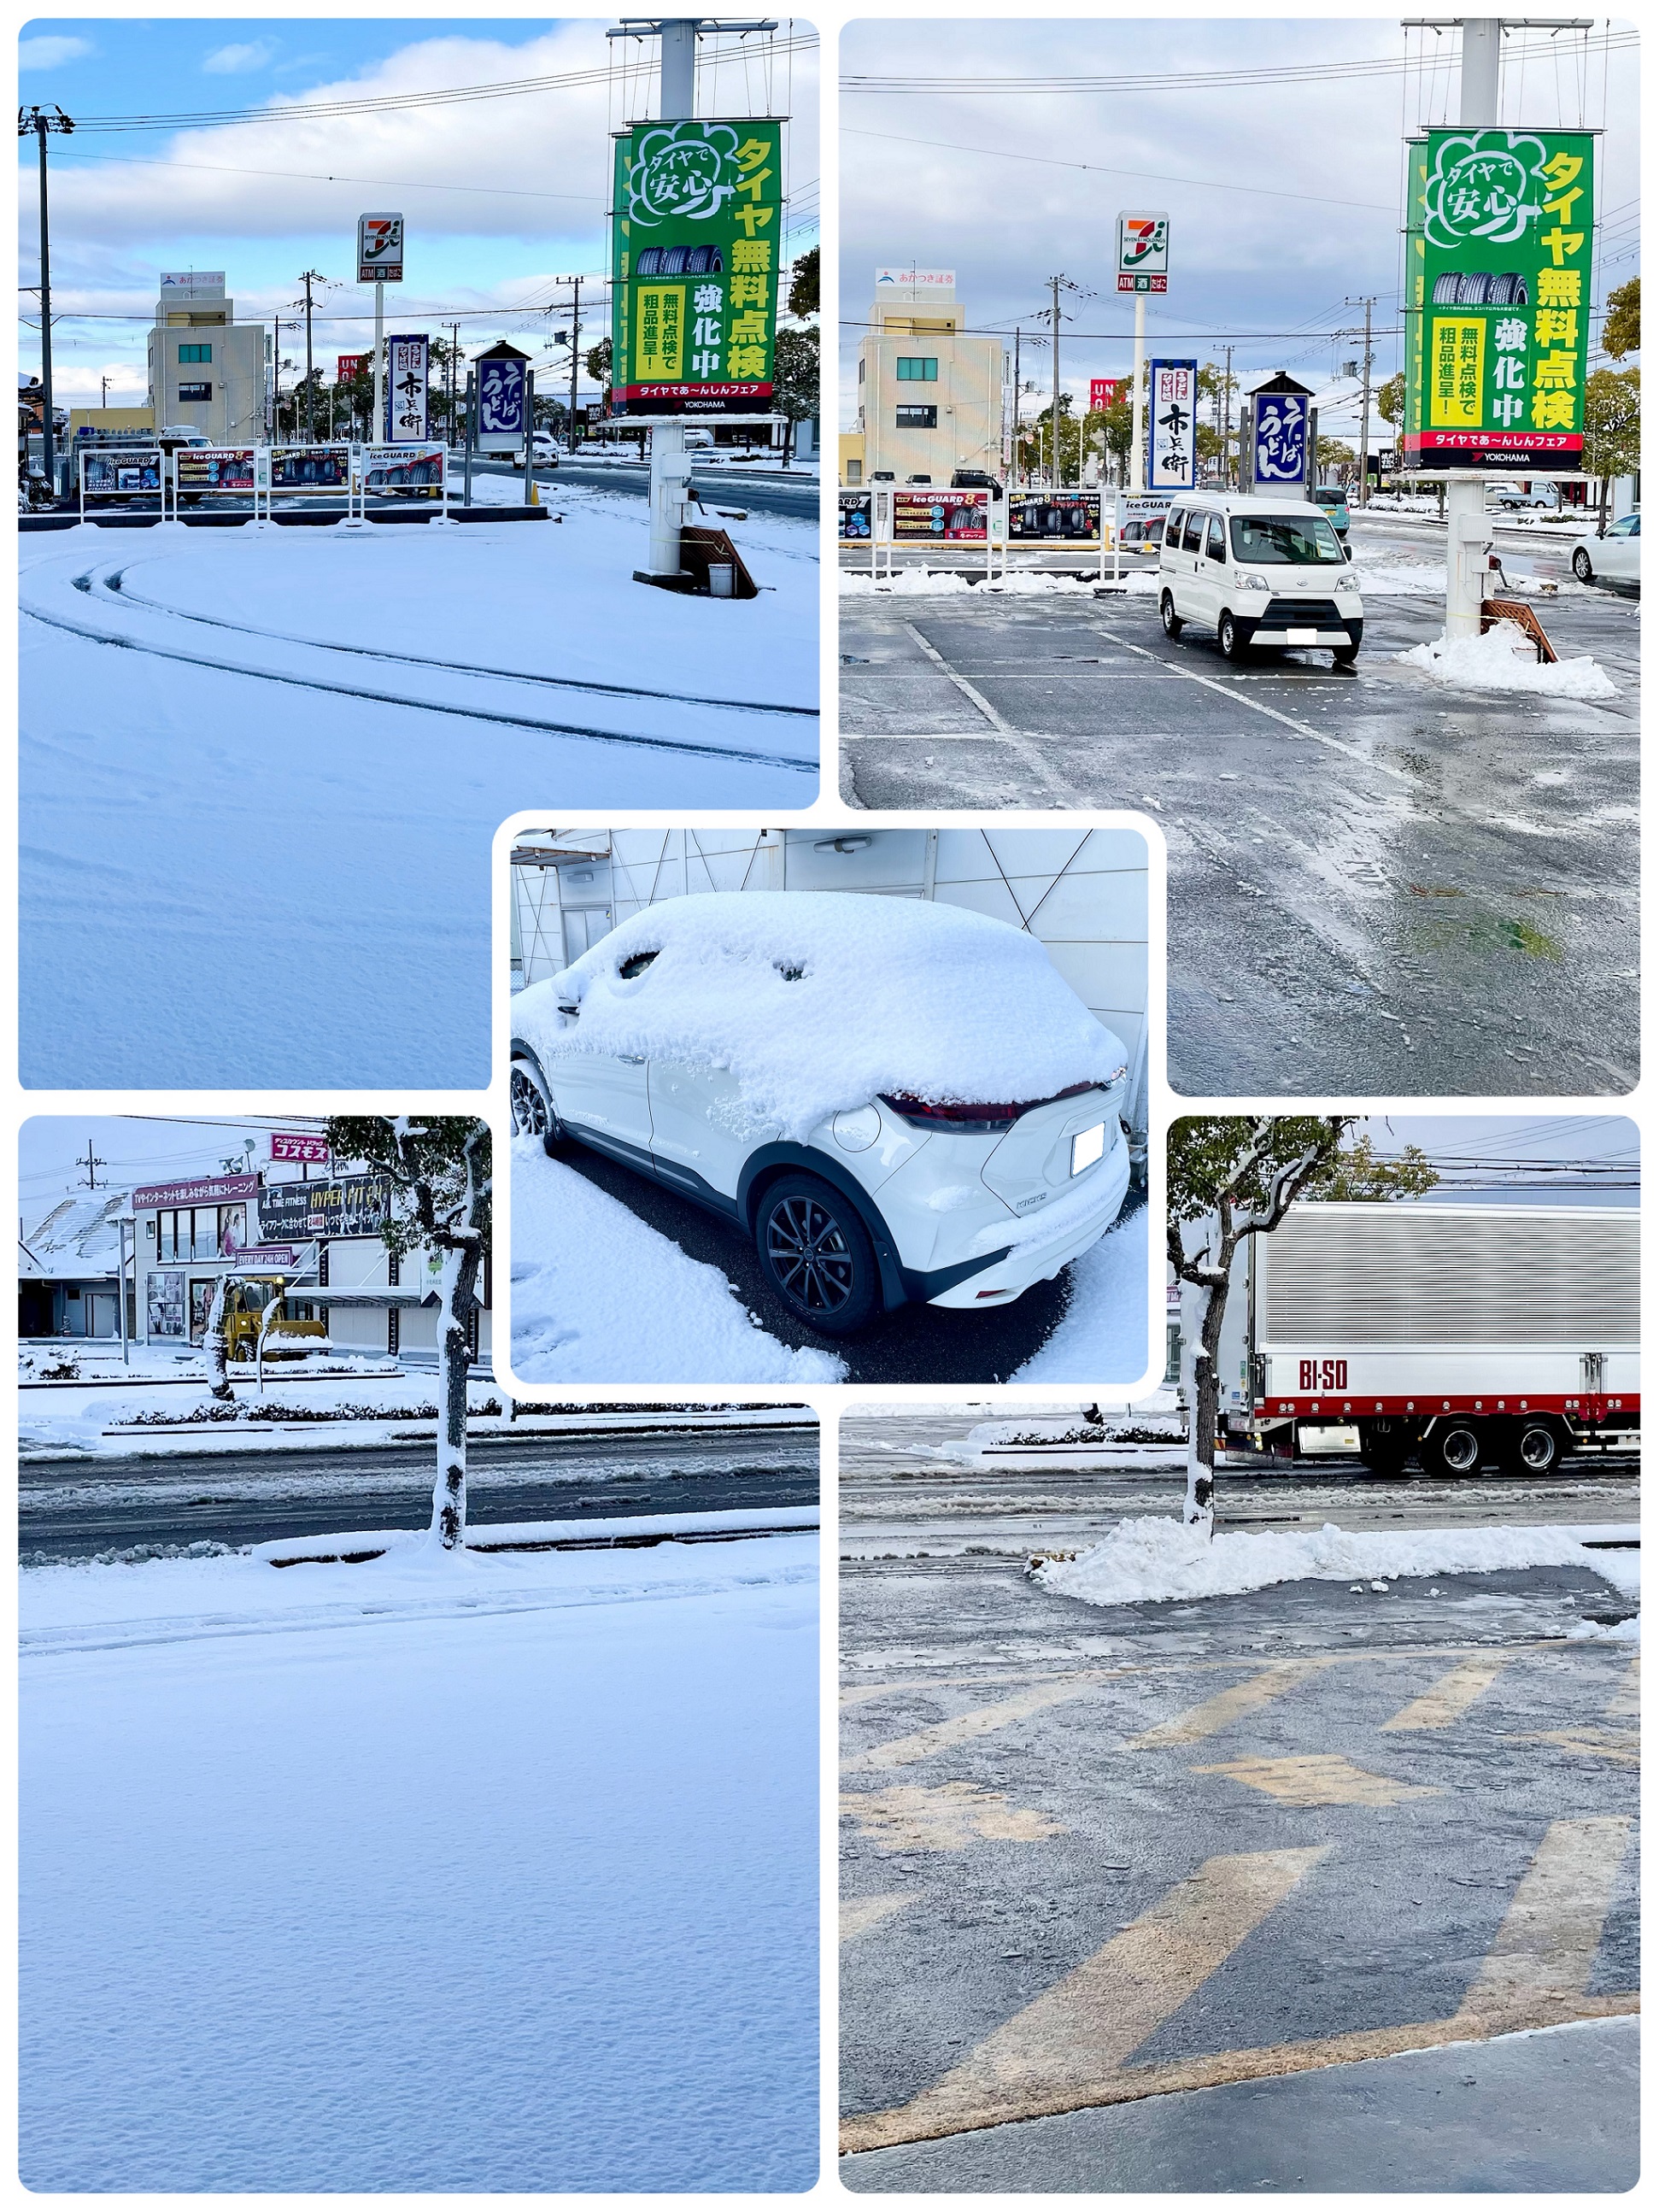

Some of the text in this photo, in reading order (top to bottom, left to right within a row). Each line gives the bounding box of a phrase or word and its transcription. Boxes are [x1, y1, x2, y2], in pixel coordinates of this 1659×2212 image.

[649, 147, 709, 174] タイヤで
[1446, 160, 1514, 187] タイヤで
[649, 169, 712, 205] 安心
[1447, 185, 1517, 224] 安心
[726, 138, 774, 380] タイヤ無料点検
[361, 268, 374, 278] ATM
[376, 268, 386, 279] 酒
[900, 273, 954, 284] あかつき証券
[1118, 277, 1134, 288] ATM
[1137, 278, 1148, 289] 酒
[1152, 279, 1166, 289] たばこ
[1531, 152, 1585, 430] タイヤ無料点検
[662, 293, 679, 370] 無料点検で
[691, 284, 724, 378] 強化中
[1459, 327, 1479, 416] 無料点検で
[1492, 317, 1528, 428] 強化中
[504, 361, 521, 418] そば
[396, 372, 424, 437] 市兵衛
[483, 369, 519, 430] うどん
[1282, 396, 1304, 464] そば
[1158, 403, 1191, 481] 市兵衛
[1258, 406, 1302, 478] うどん
[109, 455, 159, 465] iceGUARD 7
[235, 450, 243, 461] 8
[272, 449, 306, 462] iceGUARD 8
[417, 450, 426, 459] 8
[1485, 453, 1530, 462] YOKOHAMA
[858, 496, 871, 508] 7
[912, 494, 975, 504] iceGUARD 8
[1010, 494, 1051, 509] iceGUARD 8
[274, 1144, 327, 1159] コスモス
[272, 1198, 284, 1208] TIME
[284, 1196, 307, 1207] FITNESS
[238, 1254, 255, 1265] EVERY
[254, 1253, 264, 1264] DAY
[274, 1252, 288, 1264] OPEN
